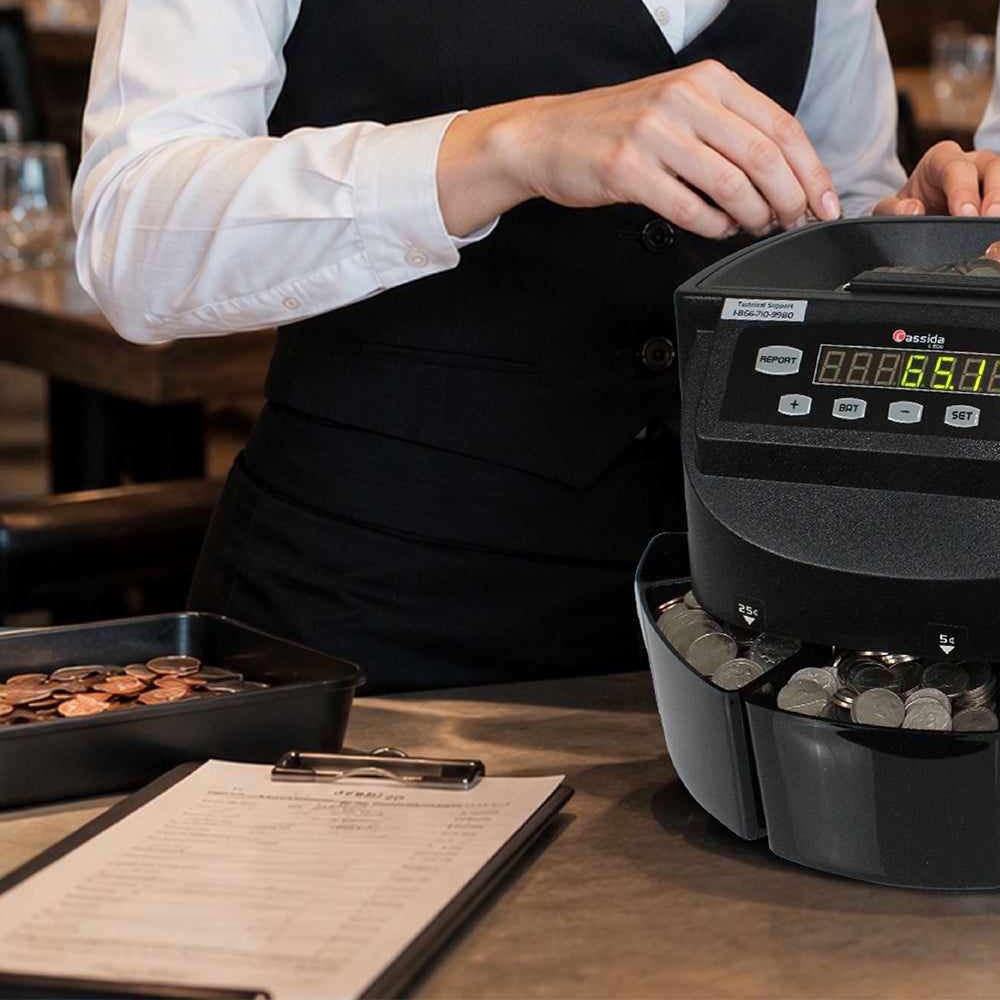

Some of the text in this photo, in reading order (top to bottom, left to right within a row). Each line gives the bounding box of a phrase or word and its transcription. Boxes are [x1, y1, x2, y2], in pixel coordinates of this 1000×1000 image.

[768, 302, 794, 310] Support
[892, 329, 945, 344] Cassida
[760, 355, 797, 364] REPORT
[839, 403, 859, 413] BAT
[952, 411, 973, 421] SET
